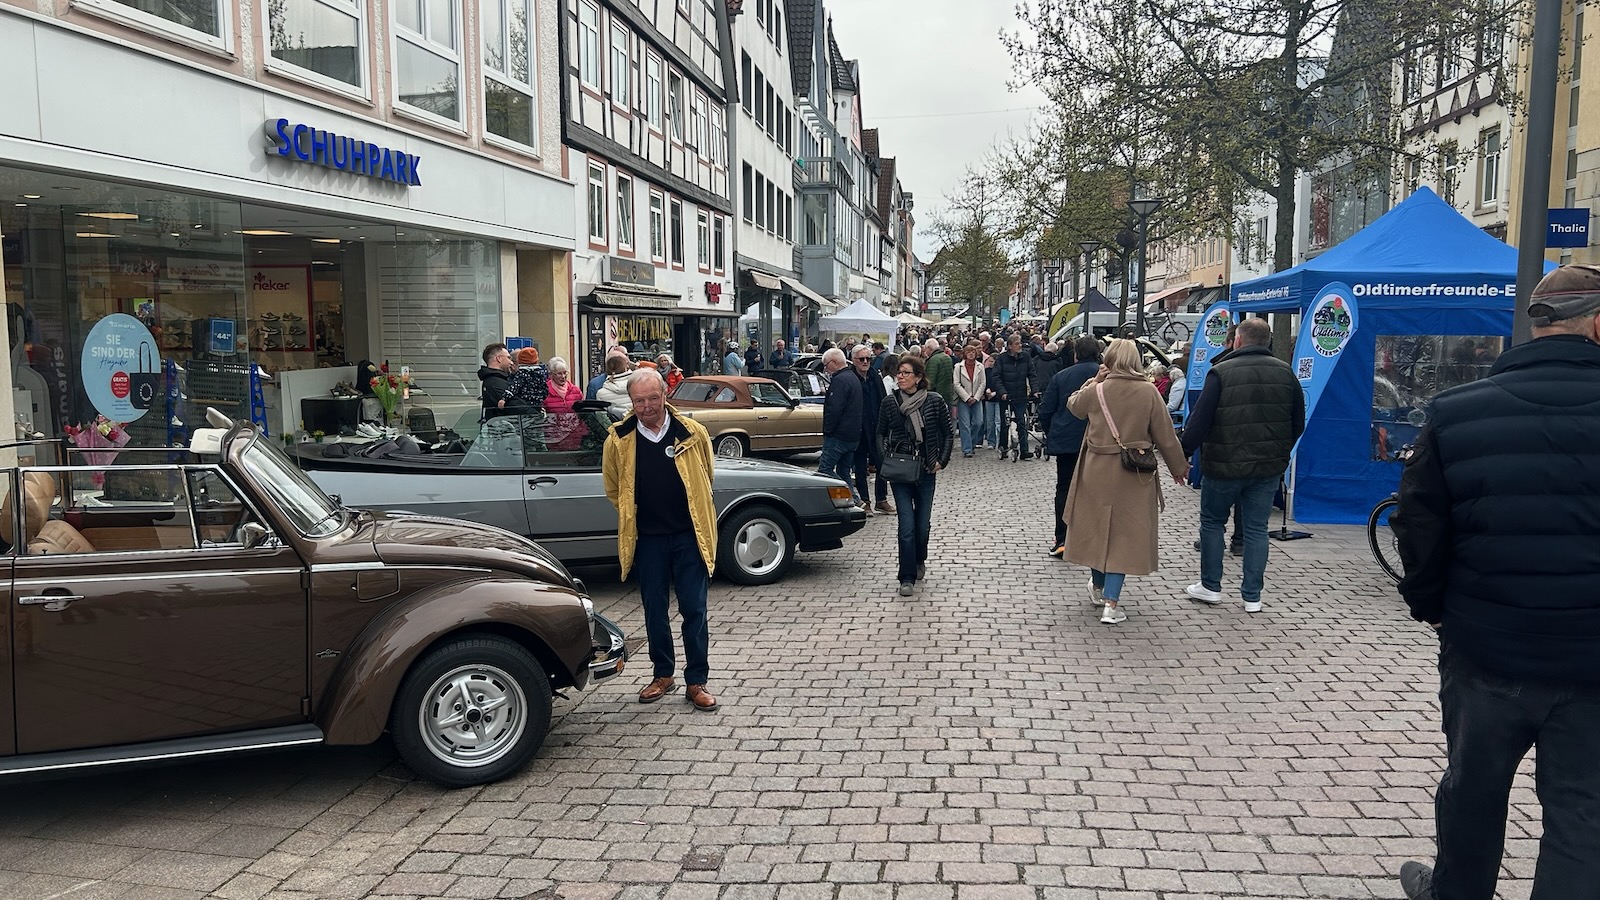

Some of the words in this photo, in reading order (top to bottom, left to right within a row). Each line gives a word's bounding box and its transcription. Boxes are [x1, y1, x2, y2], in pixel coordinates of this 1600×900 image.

[275, 118, 421, 187] SCHUHPARK
[1550, 223, 1586, 233] Thalia
[253, 280, 290, 291] rieker
[1352, 283, 1517, 297] Oldtimerfreunde-E
[105, 334, 121, 345] SIE
[91, 346, 115, 358] SIND
[117, 348, 136, 359] DER
